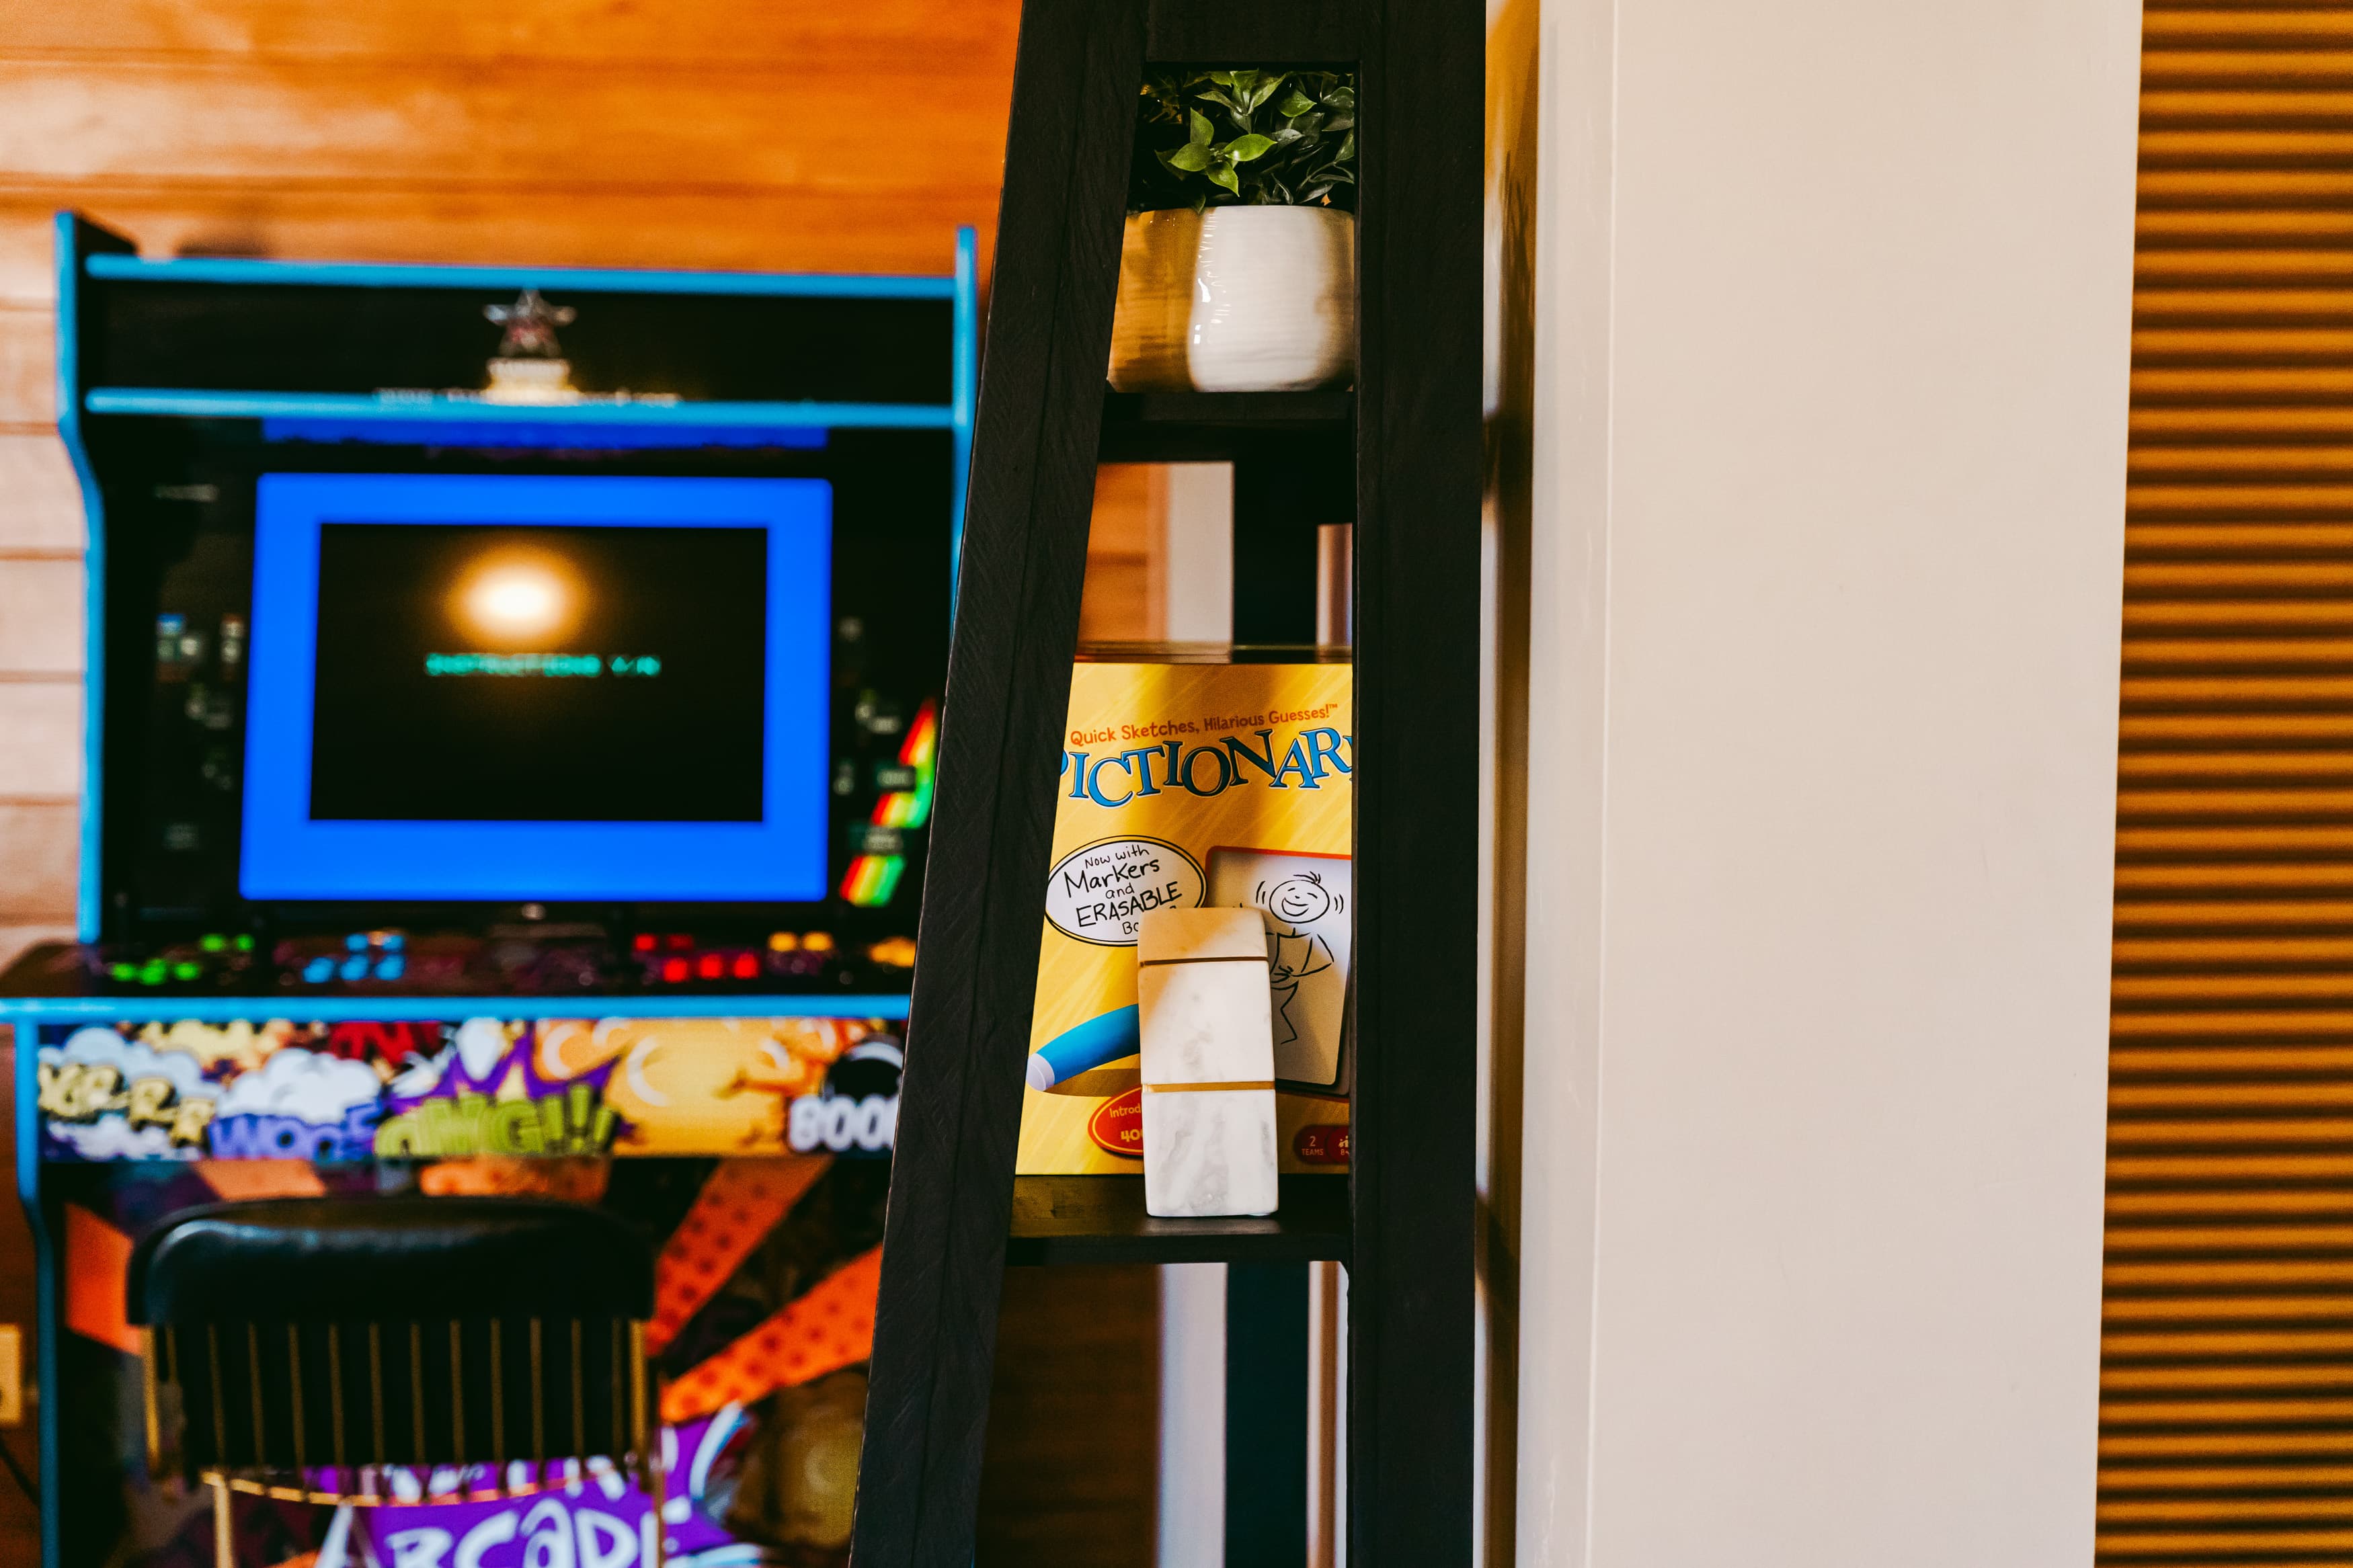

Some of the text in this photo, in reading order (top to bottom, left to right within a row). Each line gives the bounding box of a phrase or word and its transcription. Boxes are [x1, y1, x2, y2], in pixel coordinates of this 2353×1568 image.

[1070, 727, 1117, 746] Quick
[1121, 720, 1200, 740] Sketches,
[1204, 715, 1265, 732] Hilarious
[1060, 727, 1352, 808] ICTIONAR
[1084, 844, 1150, 869] Now with
[1064, 858, 1160, 899] Markers
[1105, 882, 1135, 899] and
[1076, 881, 1183, 927] ERASABLE
[789, 1092, 900, 1152] BOO
[1109, 1103, 1142, 1118] Introd
[1120, 1128, 1143, 1143] 40
[1308, 1135, 1316, 1147] 2
[1301, 1148, 1324, 1156] TEAMS
